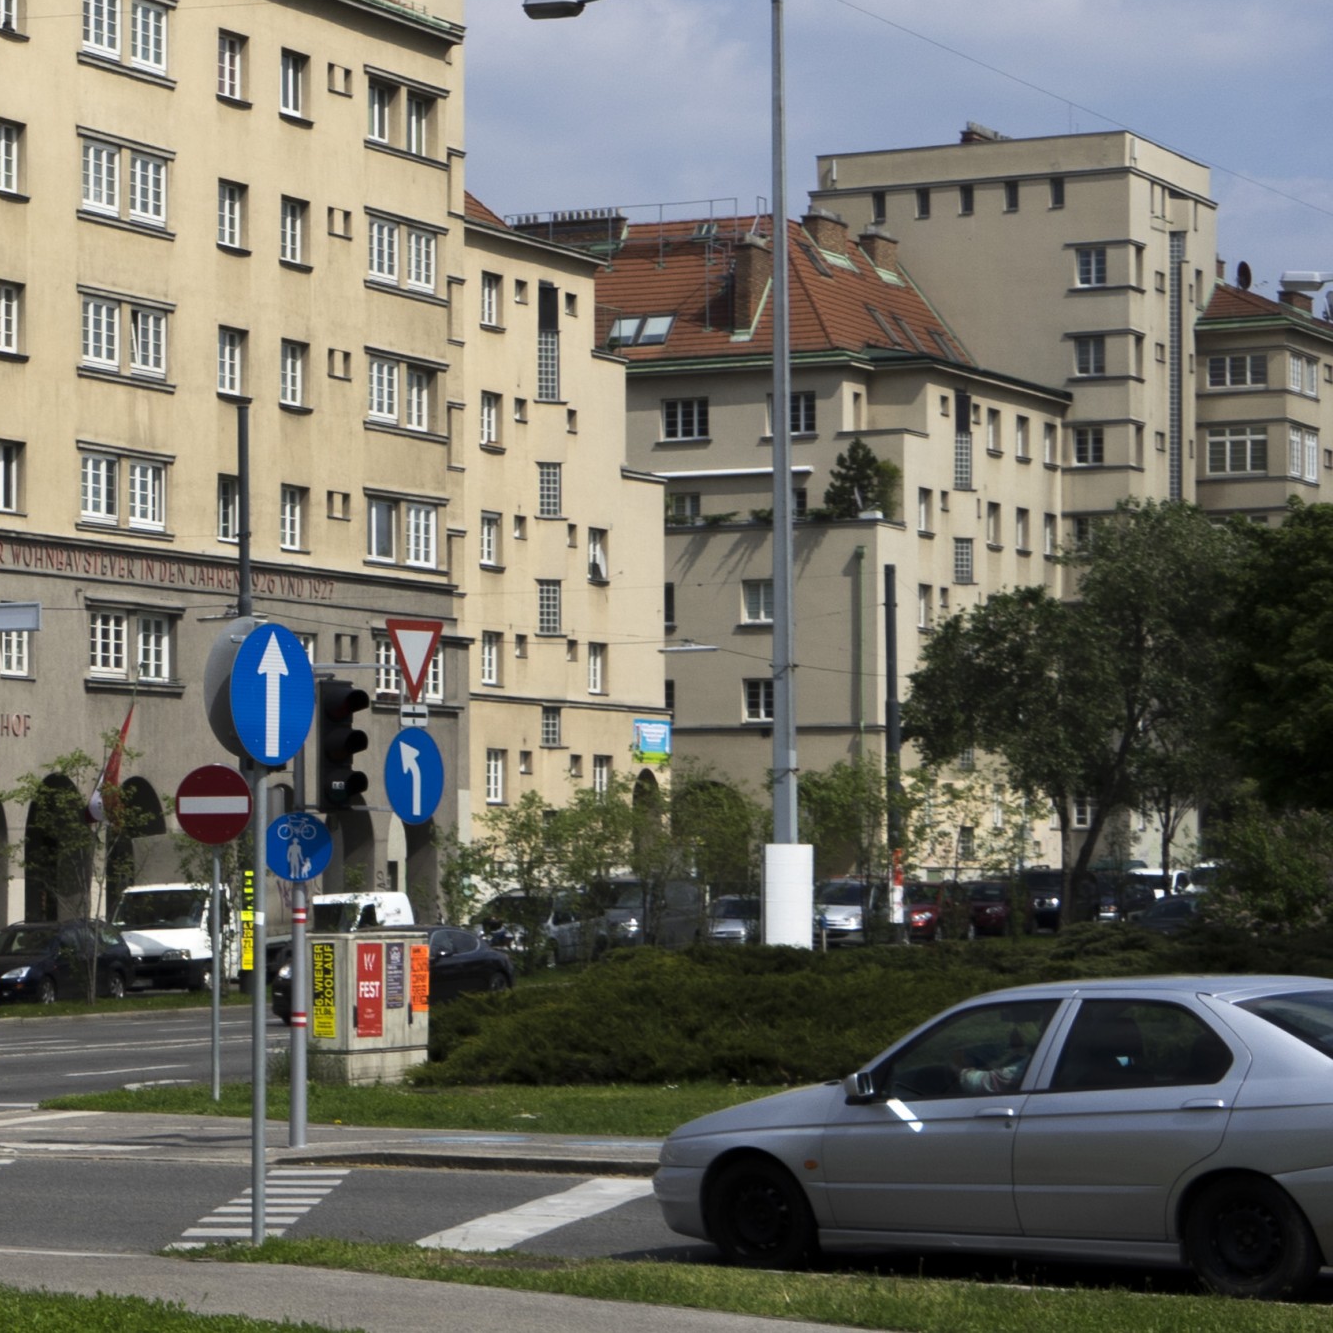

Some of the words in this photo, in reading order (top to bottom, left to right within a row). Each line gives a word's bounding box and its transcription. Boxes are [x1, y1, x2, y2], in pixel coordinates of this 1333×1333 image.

[140, 556, 155, 580] IN
[160, 559, 186, 584] DEN
[251, 571, 276, 595] 926
[308, 578, 335, 601] 1927
[0, 712, 31, 737] HOF
[314, 944, 324, 993] WIENER
[324, 944, 334, 1006] ZOOLAUF
[359, 980, 381, 998] FEST
